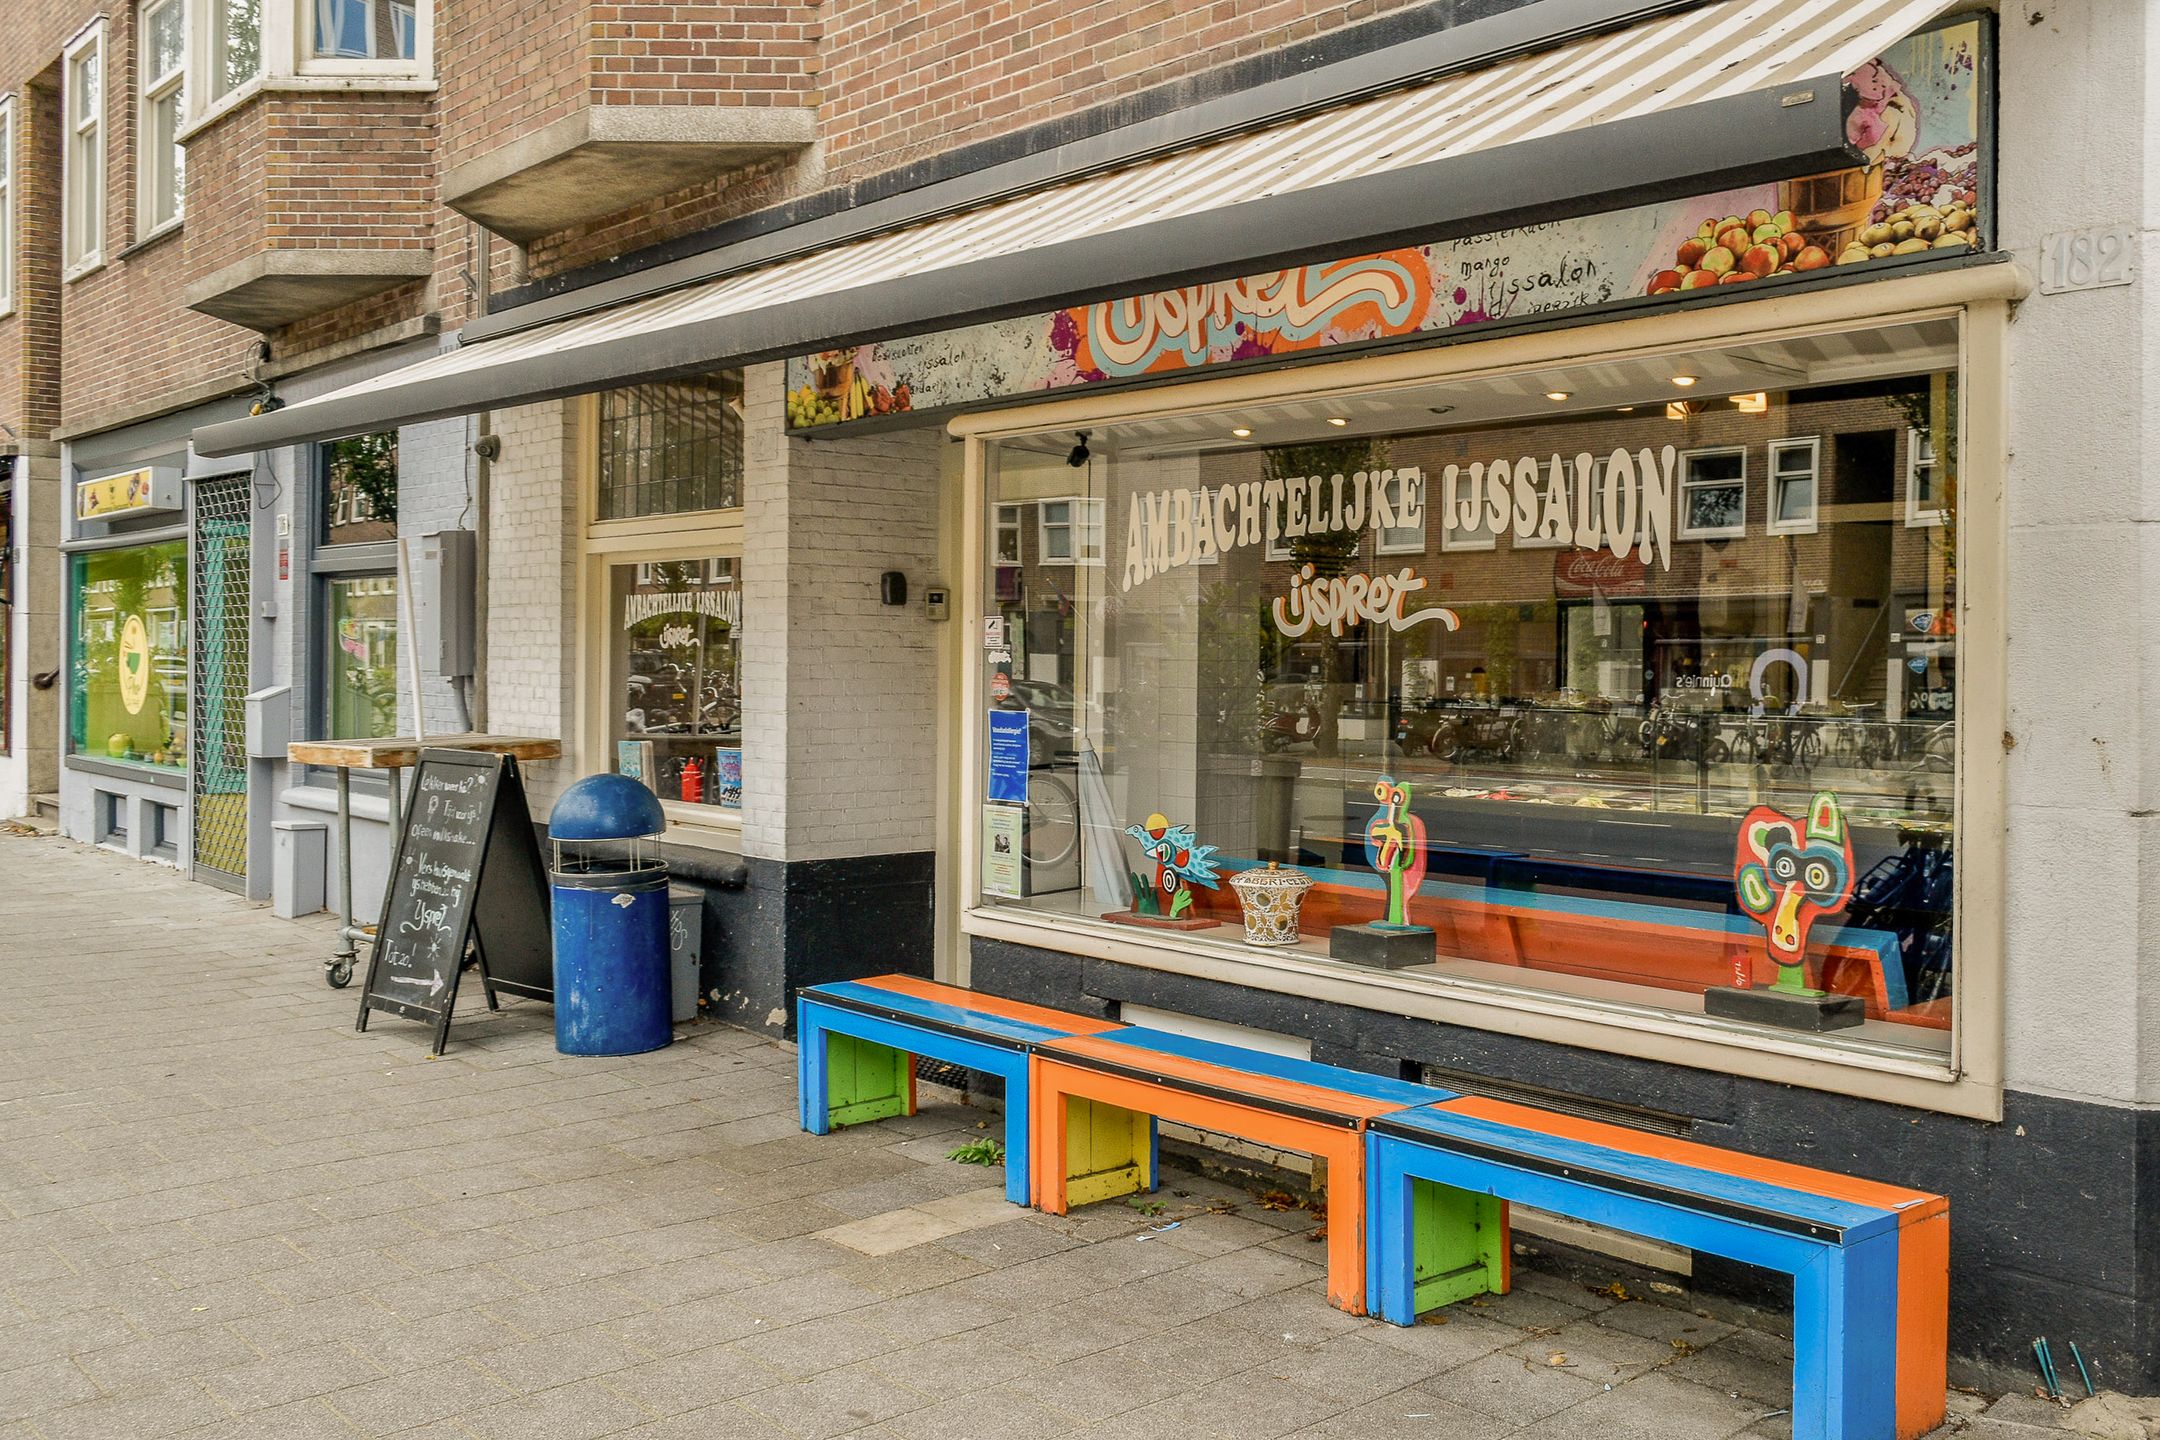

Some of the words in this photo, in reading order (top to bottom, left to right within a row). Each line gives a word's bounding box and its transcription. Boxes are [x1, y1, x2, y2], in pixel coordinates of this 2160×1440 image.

[1461, 256, 1510, 281] mango
[2051, 235, 2124, 289] 182
[1122, 466, 1424, 592] AMBACHTELIJKE
[1443, 444, 1676, 572] IJSSALON
[624, 592, 693, 630] AMBACHTELIJKE
[696, 590, 741, 627] IJSSALON
